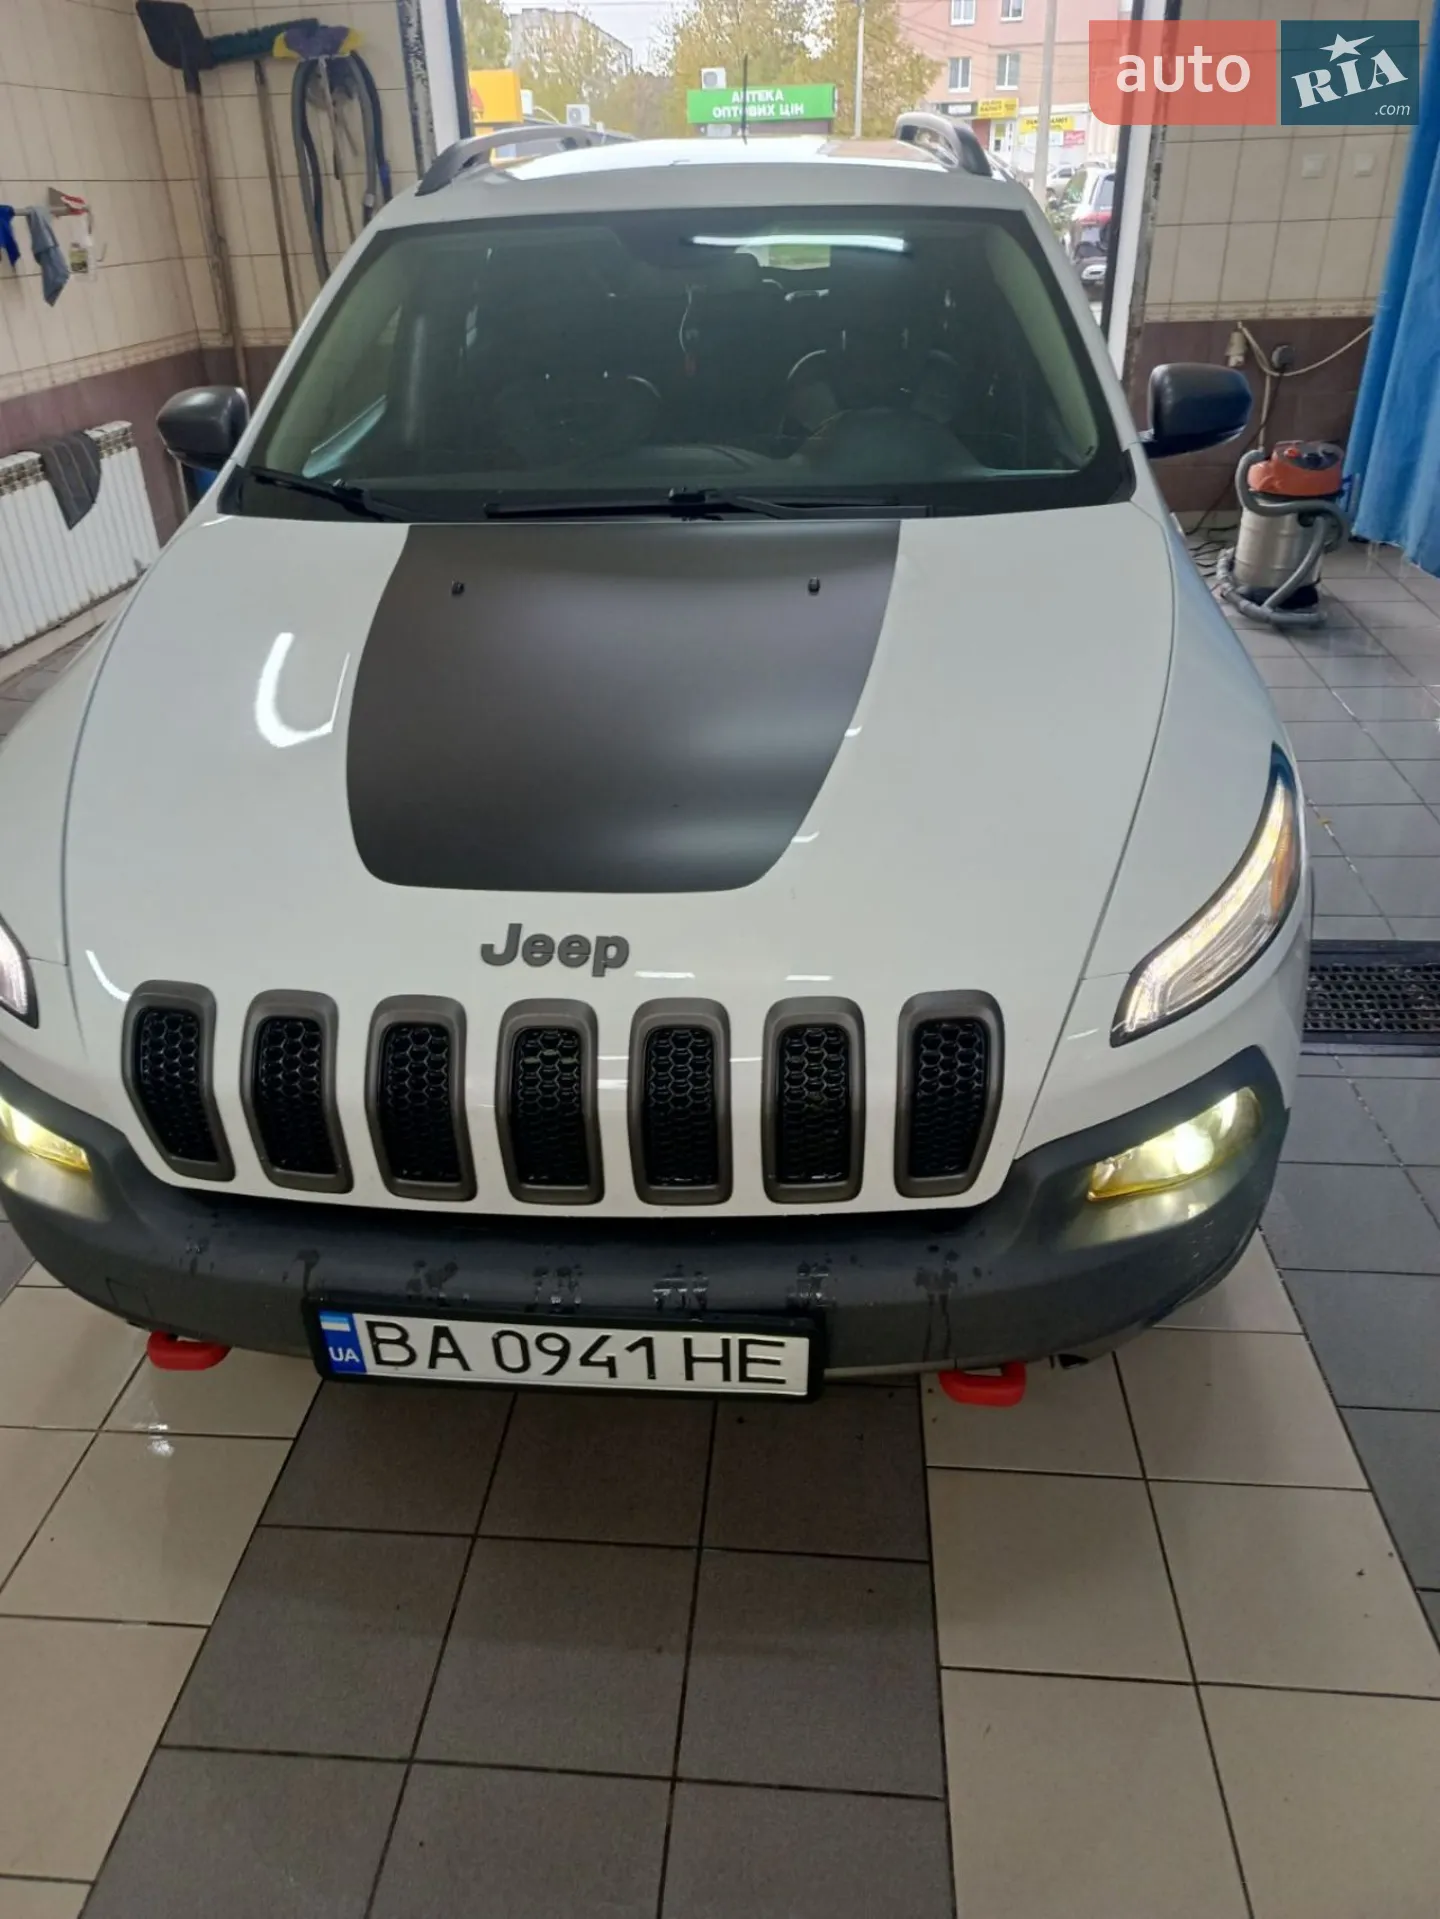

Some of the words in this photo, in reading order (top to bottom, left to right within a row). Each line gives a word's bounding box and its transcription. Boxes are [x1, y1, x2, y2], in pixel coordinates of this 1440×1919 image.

[731, 89, 784, 104] АПТЕКА
[779, 103, 804, 117] ЦІН
[480, 922, 630, 978] Jeep
[330, 1346, 360, 1365] UA
[366, 1320, 472, 1371] BA
[492, 1329, 656, 1379] 0941
[683, 1337, 787, 1385] HE
